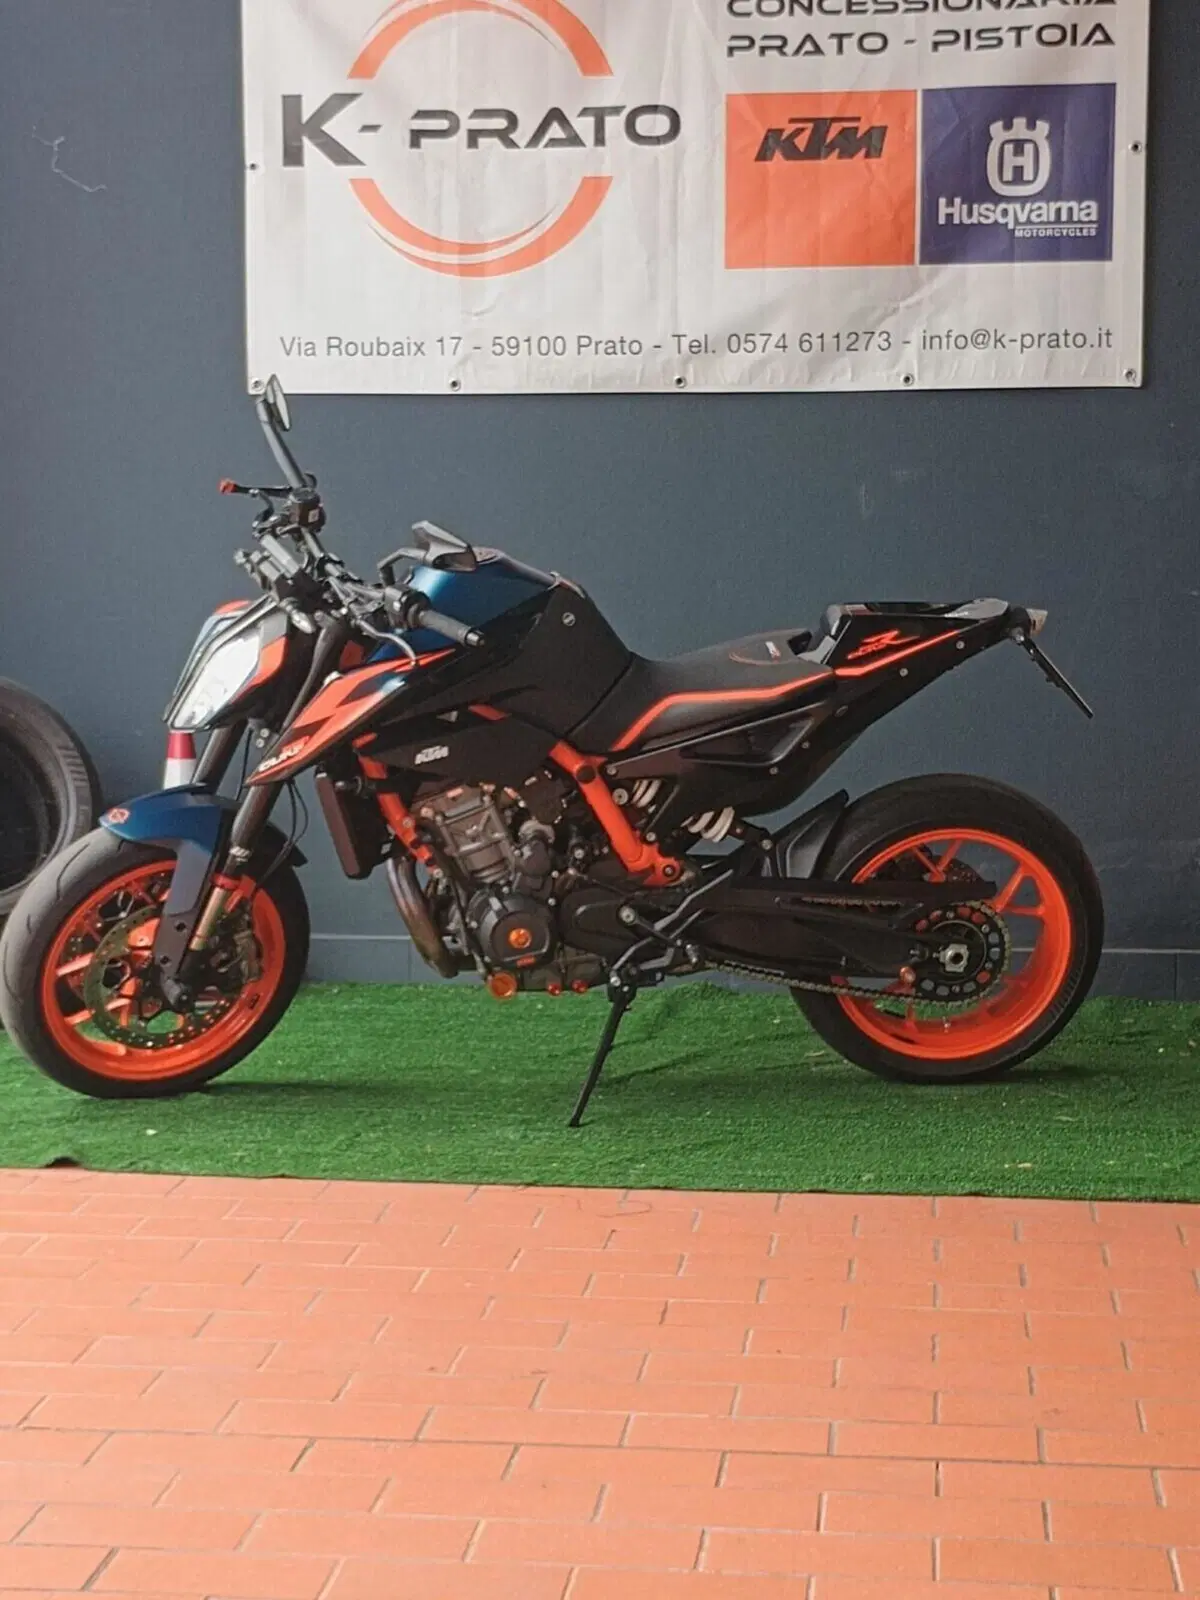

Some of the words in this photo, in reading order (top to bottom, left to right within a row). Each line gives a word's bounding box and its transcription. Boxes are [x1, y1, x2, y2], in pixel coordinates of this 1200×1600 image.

[727, 0, 1117, 18] CONCESSIO
[727, 32, 888, 57] PRATO
[931, 22, 1115, 52] PISTOIA
[409, 104, 681, 149] PRATO
[755, 116, 888, 162] KTM
[938, 197, 1098, 229] Husqvarna
[1014, 228, 1097, 237] MOTORCYCLES
[280, 336, 317, 357] Via
[326, 336, 426, 357] Roubaix
[436, 336, 463, 356] 17
[491, 335, 567, 357] 59100
[576, 335, 643, 356] Prato
[672, 334, 716, 355] Tel.
[727, 333, 788, 354] 0574
[798, 331, 892, 352] 611273
[922, 328, 1113, 354] info@k-prato.it
[414, 745, 449, 765] KTM
